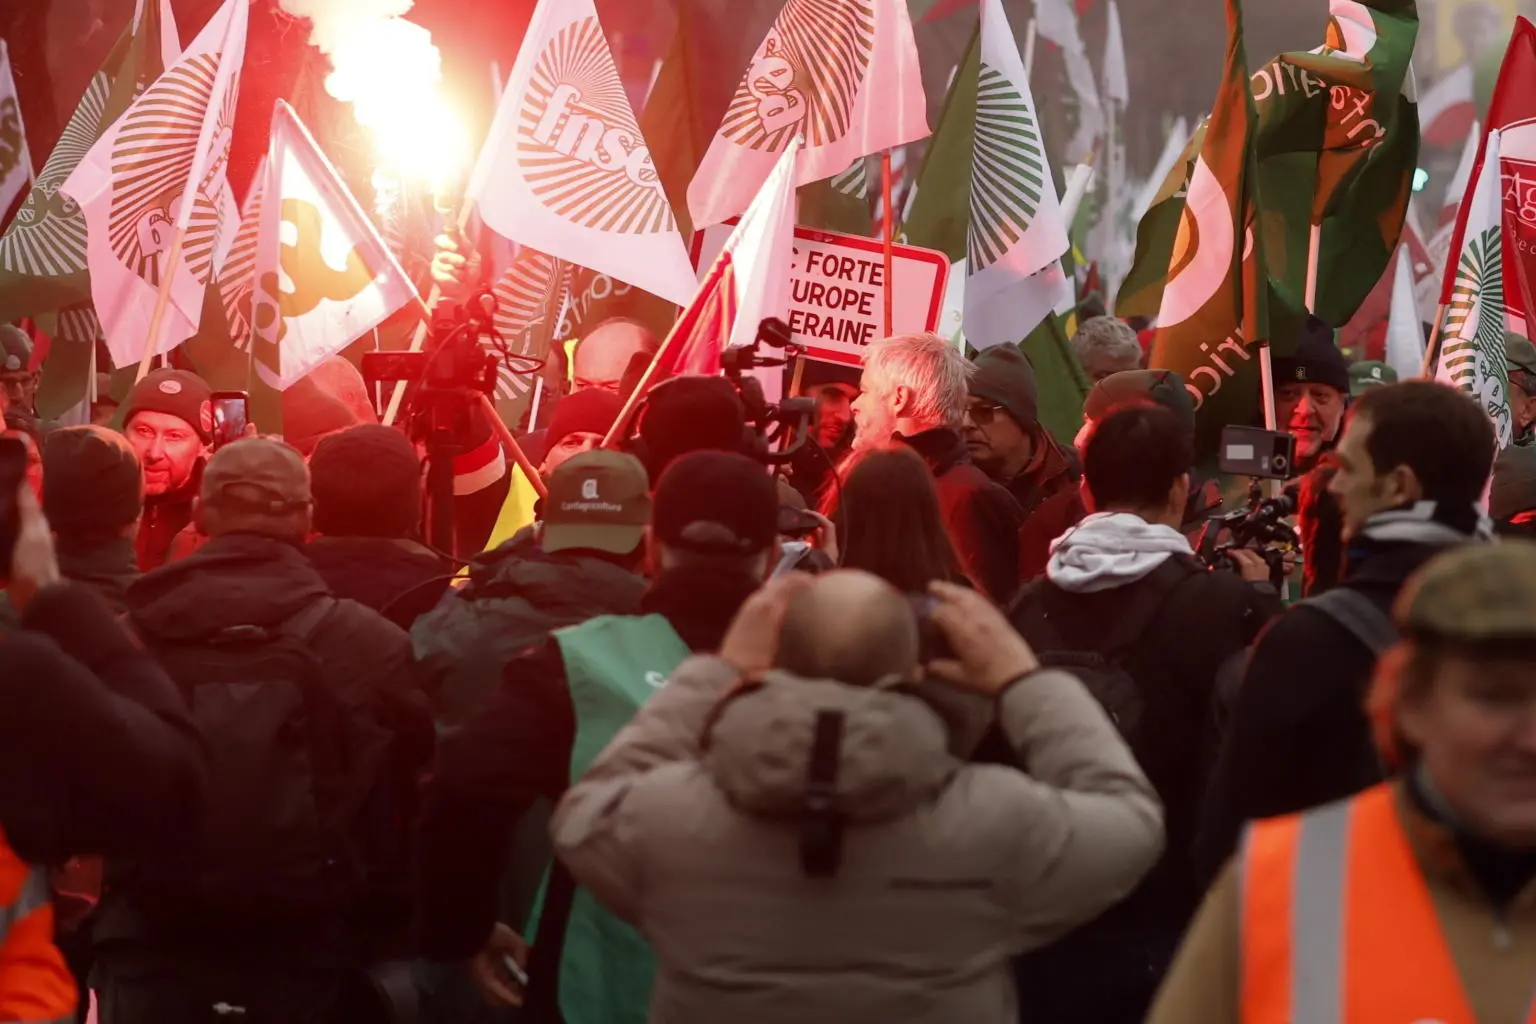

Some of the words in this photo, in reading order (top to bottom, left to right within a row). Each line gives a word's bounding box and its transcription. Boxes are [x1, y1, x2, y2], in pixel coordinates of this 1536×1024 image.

[531, 83, 664, 190] fnse
[805, 250, 885, 287] FORTE
[790, 277, 875, 316] UROPE
[787, 308, 877, 347] ERAINE
